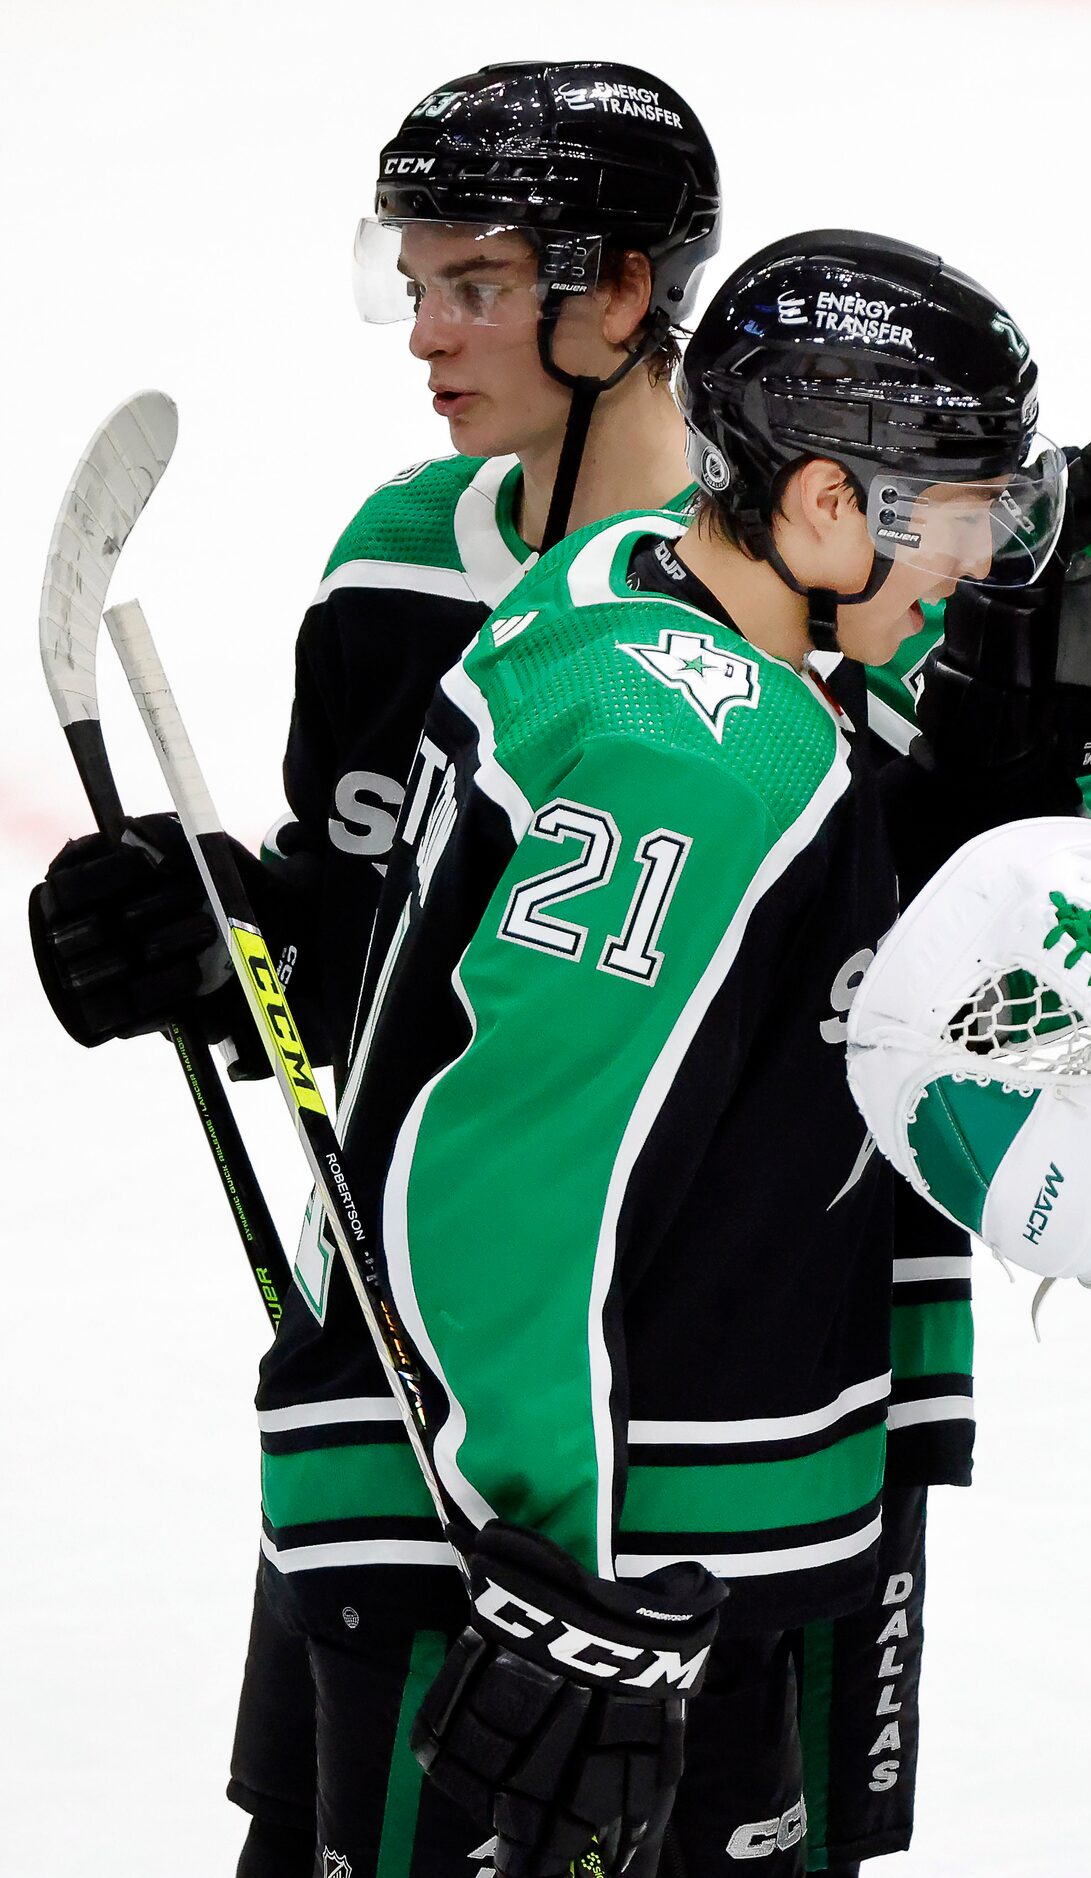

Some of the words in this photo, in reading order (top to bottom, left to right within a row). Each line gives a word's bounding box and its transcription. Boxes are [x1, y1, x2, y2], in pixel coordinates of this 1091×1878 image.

[594, 81, 660, 106] ENERGY
[600, 98, 683, 129] TRANSFER
[384, 158, 436, 176] CCM
[550, 282, 588, 293] BAUER
[816, 291, 896, 321] ENERGY
[815, 310, 914, 349] TRANSFER
[876, 527, 922, 545] BAUER
[497, 797, 694, 988] 21
[281, 945, 298, 993] CC
[248, 954, 316, 1092] CCM
[188, 1073, 208, 1111] LANCER
[203, 1117, 226, 1162] RELEASE
[220, 1163, 238, 1194] QUICK
[325, 1152, 365, 1242] ROBERTSON
[230, 1195, 255, 1241] DYNAMIC
[1024, 1164, 1065, 1246] MACH
[256, 1267, 283, 1330] UER
[473, 1577, 711, 1691] CCM
[637, 1609, 693, 1622] ROBERTSON
[868, 1572, 914, 1793] DALLAS
